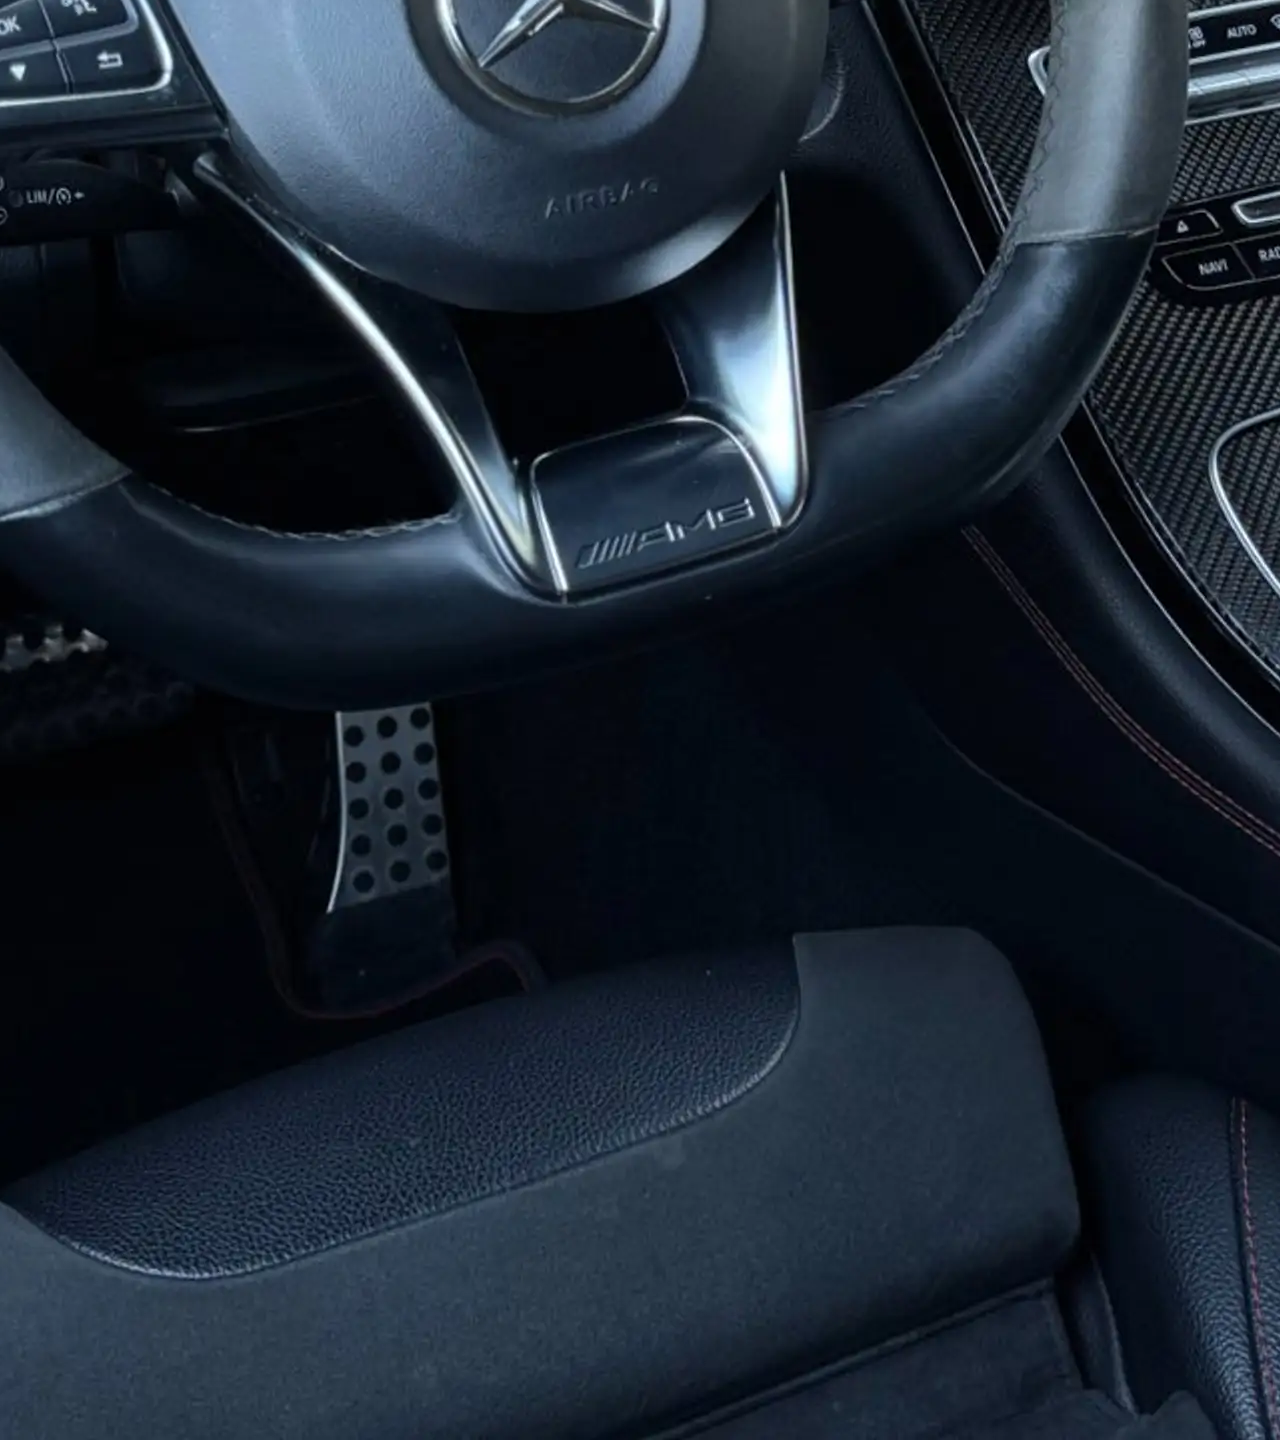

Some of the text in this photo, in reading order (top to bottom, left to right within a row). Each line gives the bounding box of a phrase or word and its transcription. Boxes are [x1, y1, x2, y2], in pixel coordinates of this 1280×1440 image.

[1227, 24, 1258, 38] AUTO
[545, 177, 659, 219] AIRBAG
[1198, 259, 1228, 276] NAVI
